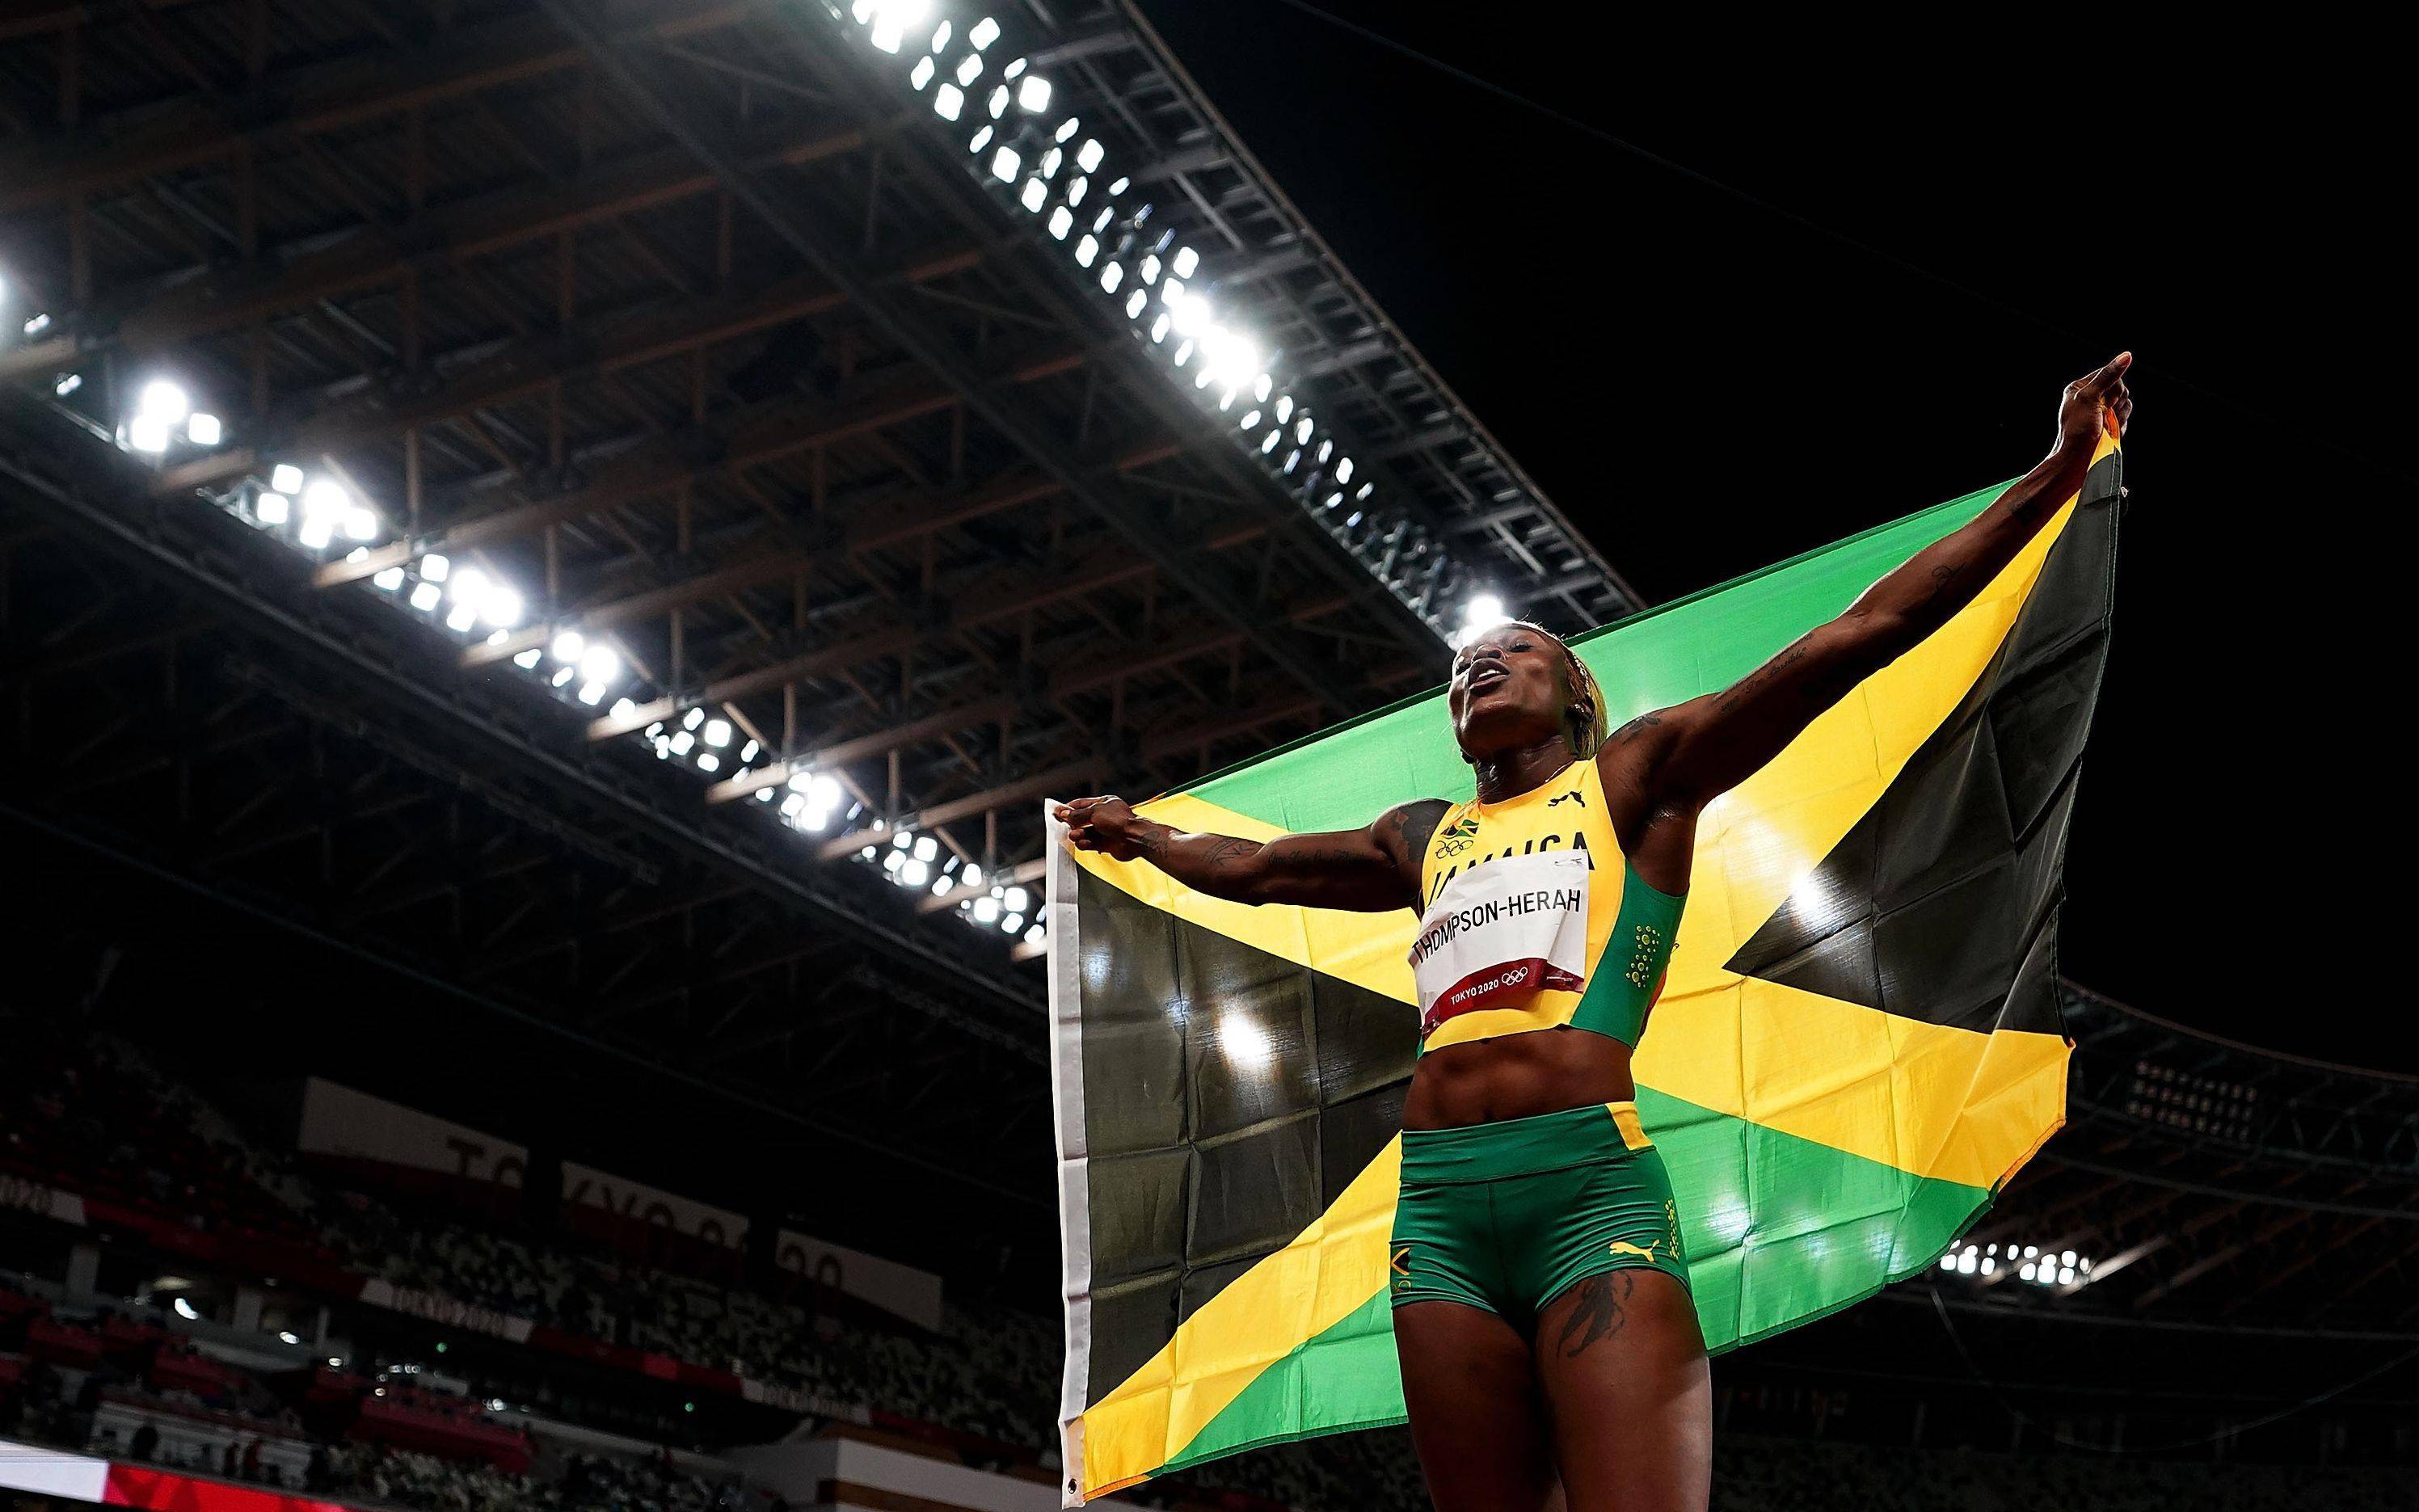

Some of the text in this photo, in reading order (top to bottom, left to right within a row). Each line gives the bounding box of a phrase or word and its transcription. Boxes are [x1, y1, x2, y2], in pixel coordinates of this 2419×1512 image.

[1412, 888, 1581, 963] THOMPSON-HERAH
[1450, 979, 1499, 1005] TOKYO 2020
